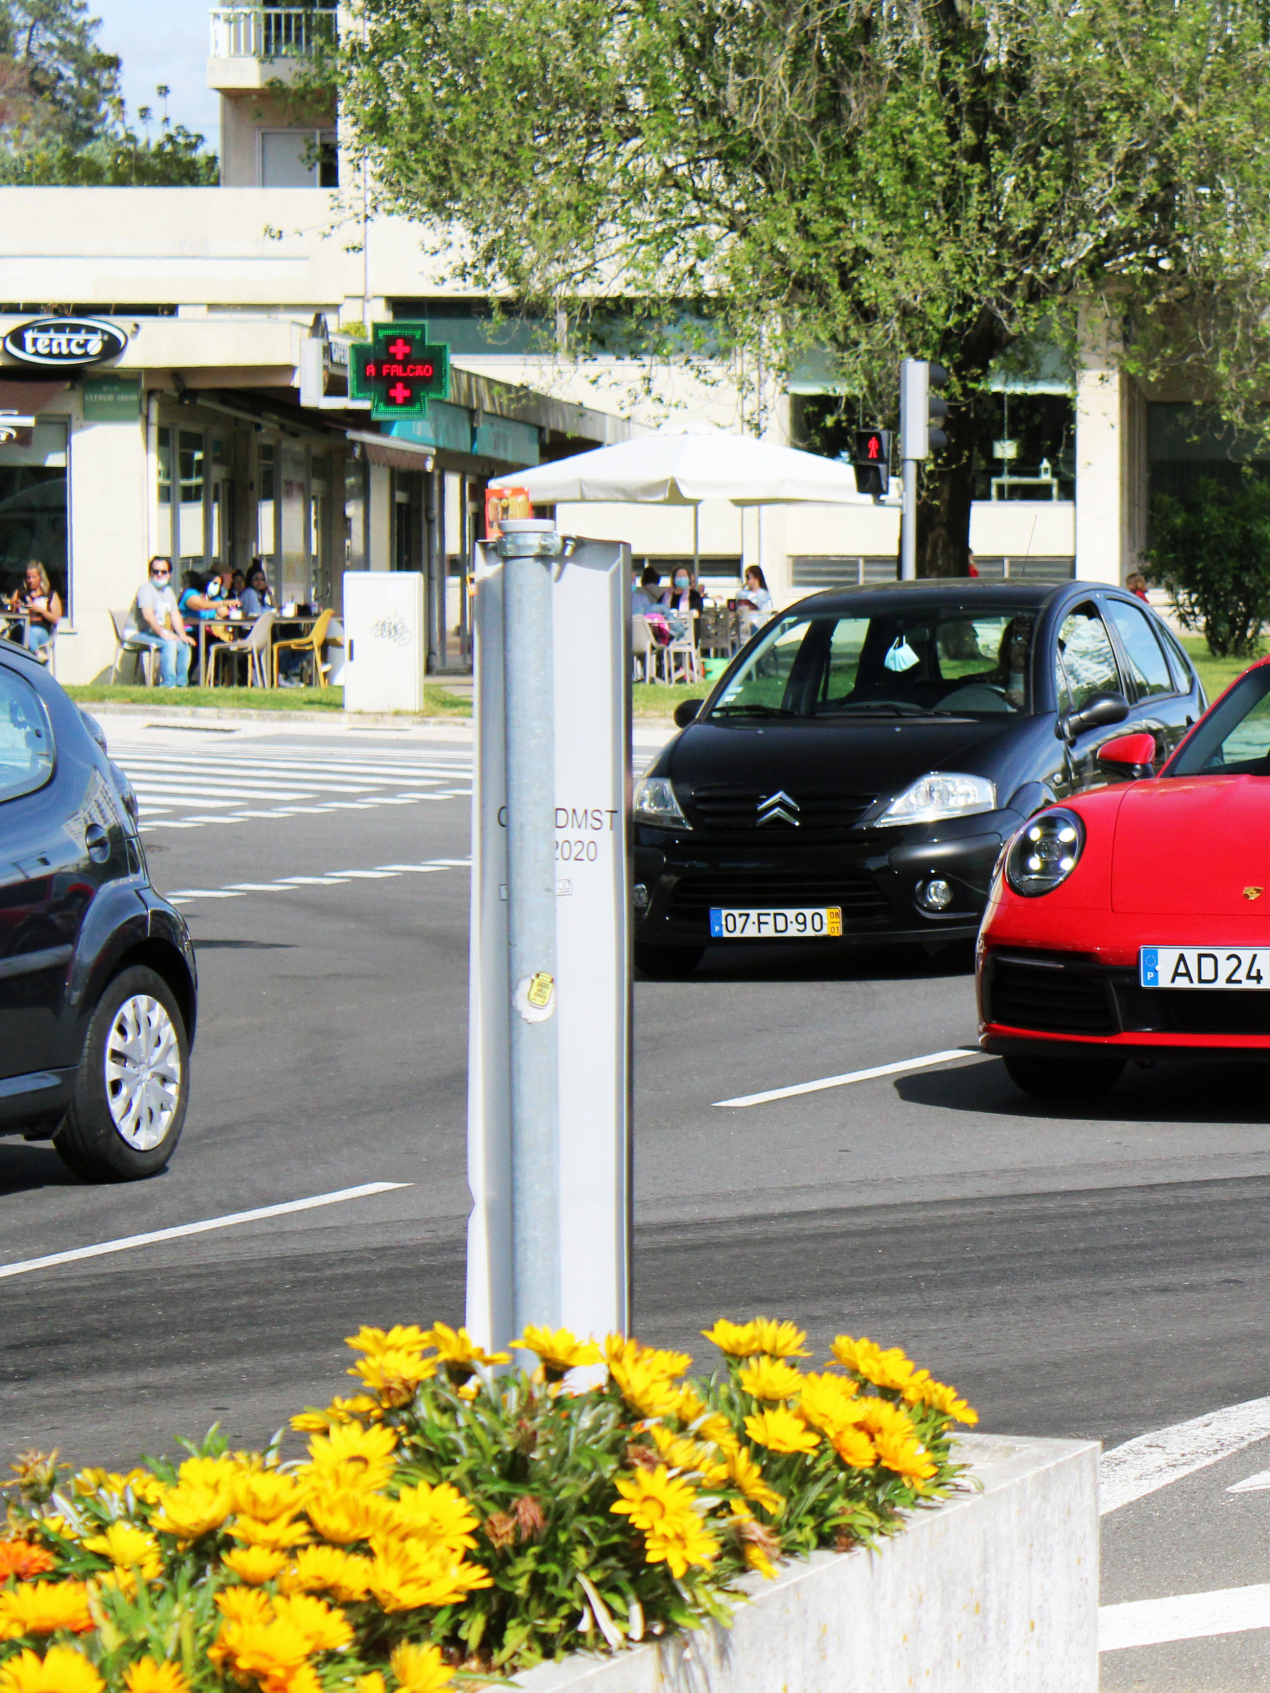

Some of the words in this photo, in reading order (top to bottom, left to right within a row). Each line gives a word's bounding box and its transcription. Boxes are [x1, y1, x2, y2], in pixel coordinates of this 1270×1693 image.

[366, 364, 376, 377] A
[382, 364, 433, 377] FALCÃO
[714, 925, 720, 933] P
[1147, 971, 1155, 981] P
